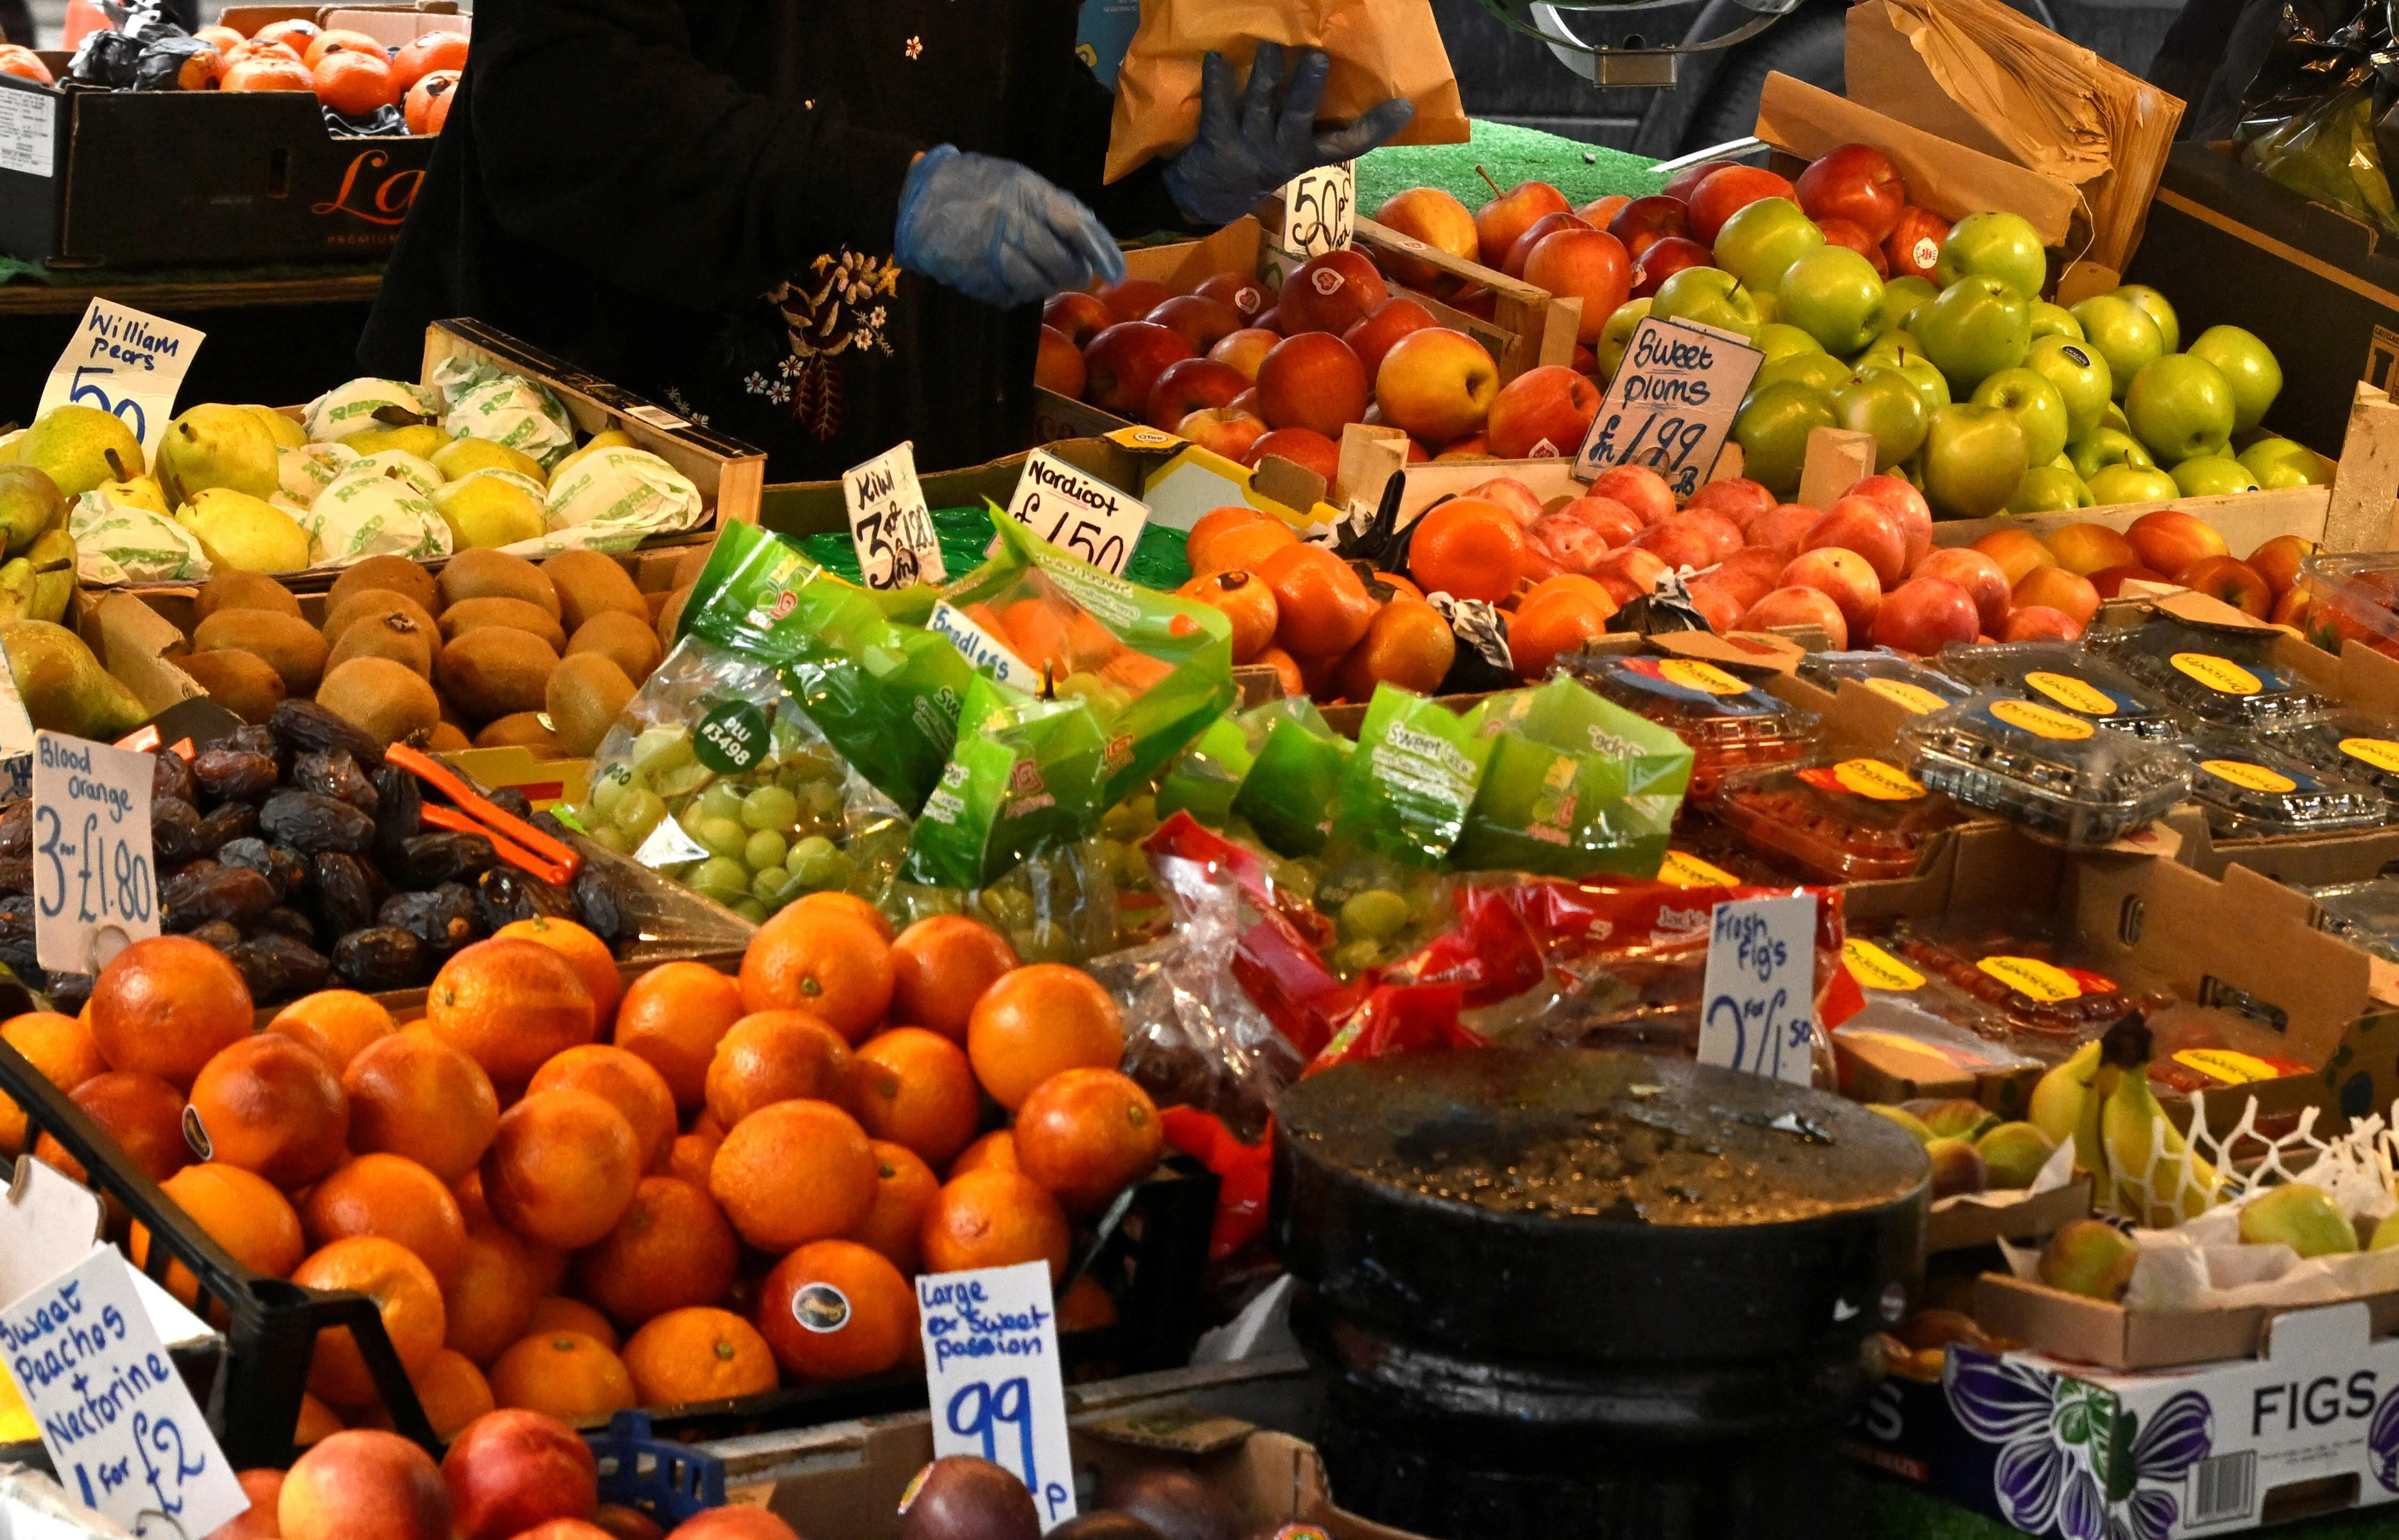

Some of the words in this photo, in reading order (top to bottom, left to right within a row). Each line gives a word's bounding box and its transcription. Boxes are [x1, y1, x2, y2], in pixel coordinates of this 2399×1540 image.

[88, 305, 180, 357] William
[1634, 328, 1714, 370] Sweet
[724, 716, 752, 743] PLU
[39, 736, 91, 775] Blood
[36, 805, 65, 917] 3
[1715, 904, 1767, 943] Fresh
[921, 1281, 988, 1318] Large
[2252, 1368, 2378, 1436] FIGS
